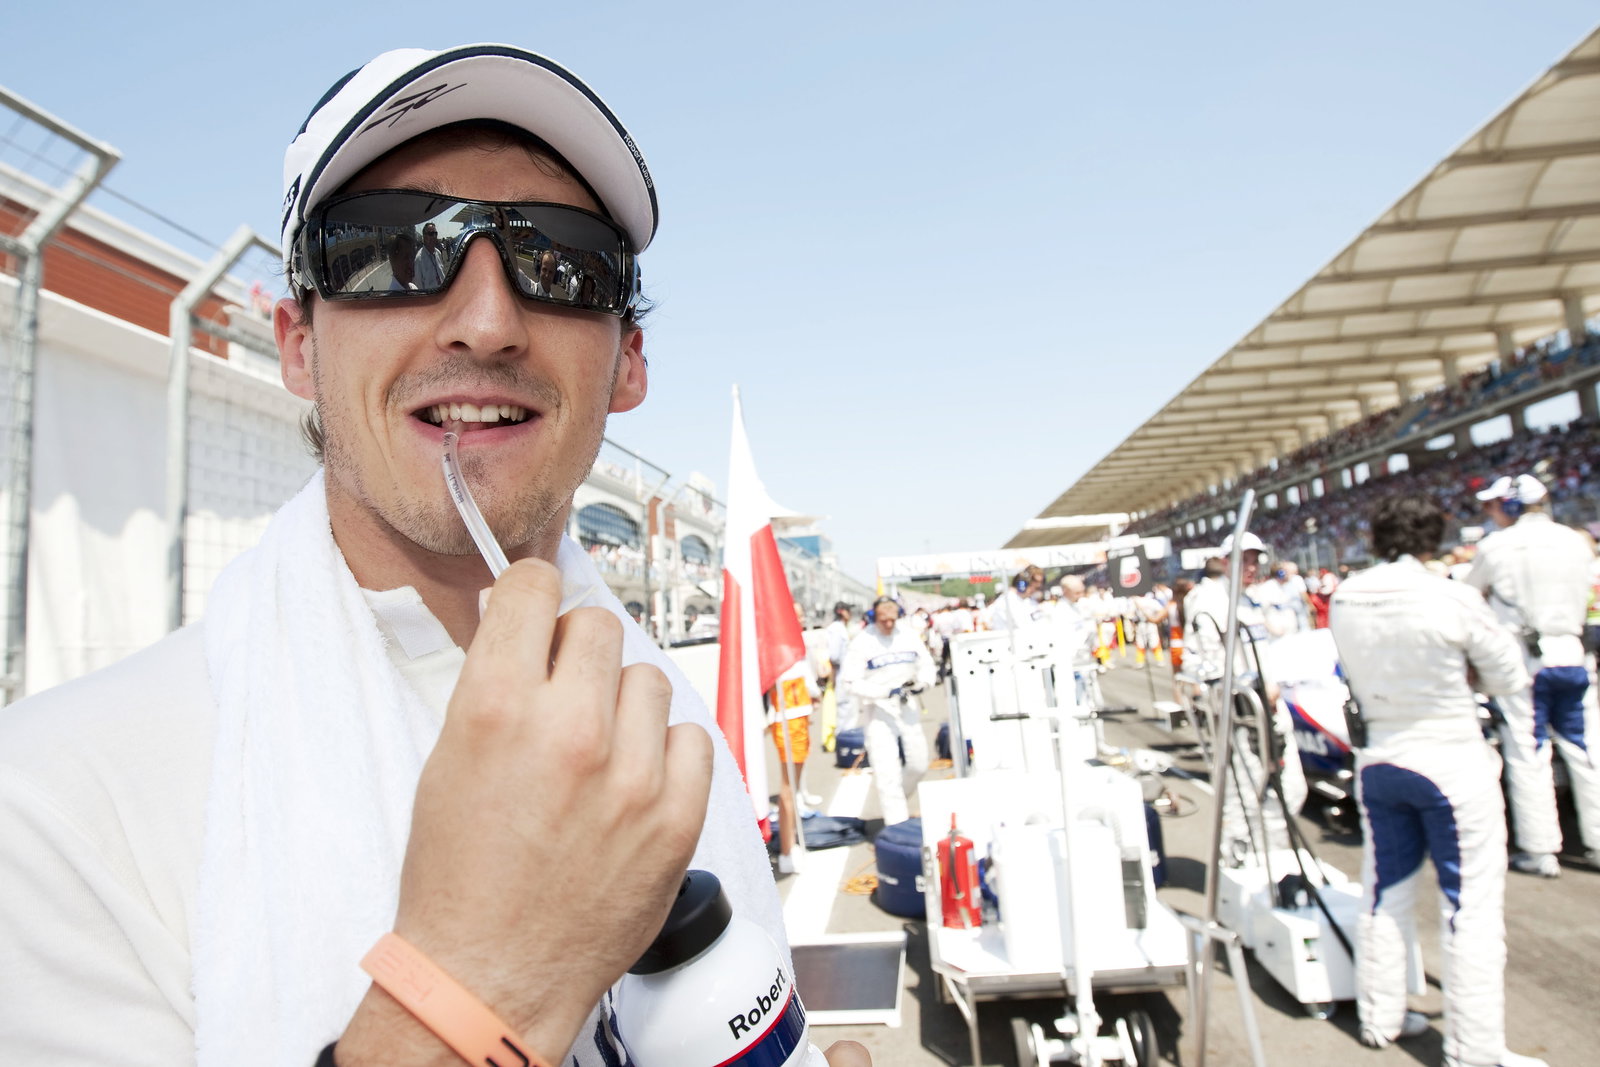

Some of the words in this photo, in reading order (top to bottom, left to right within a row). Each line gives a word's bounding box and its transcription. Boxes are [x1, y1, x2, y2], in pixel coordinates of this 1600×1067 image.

[623, 133, 644, 163] Robert
[640, 162, 653, 189] Kubica
[728, 967, 786, 1040] Robert
